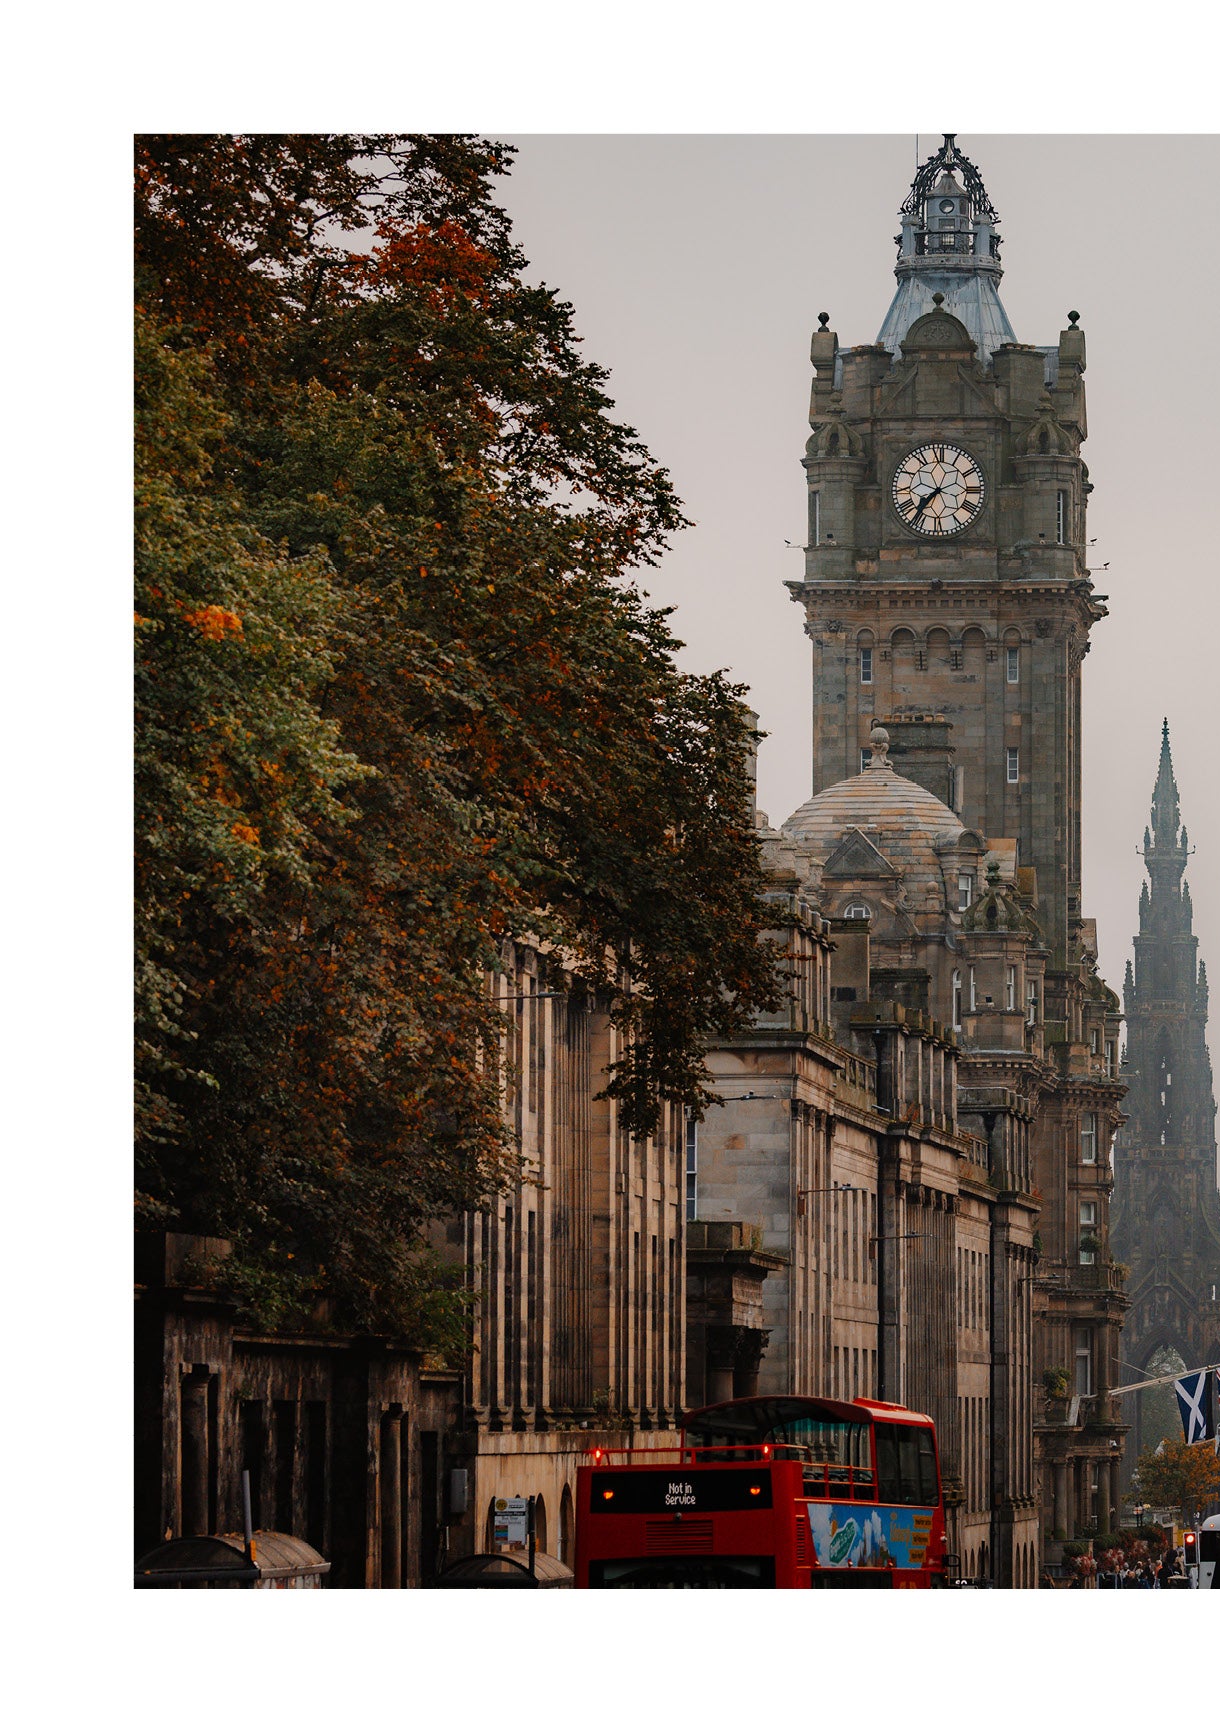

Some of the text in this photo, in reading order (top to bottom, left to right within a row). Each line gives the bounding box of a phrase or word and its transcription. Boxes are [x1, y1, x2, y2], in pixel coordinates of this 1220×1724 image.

[668, 1482, 692, 1494] Not in
[665, 1493, 696, 1505] Service
